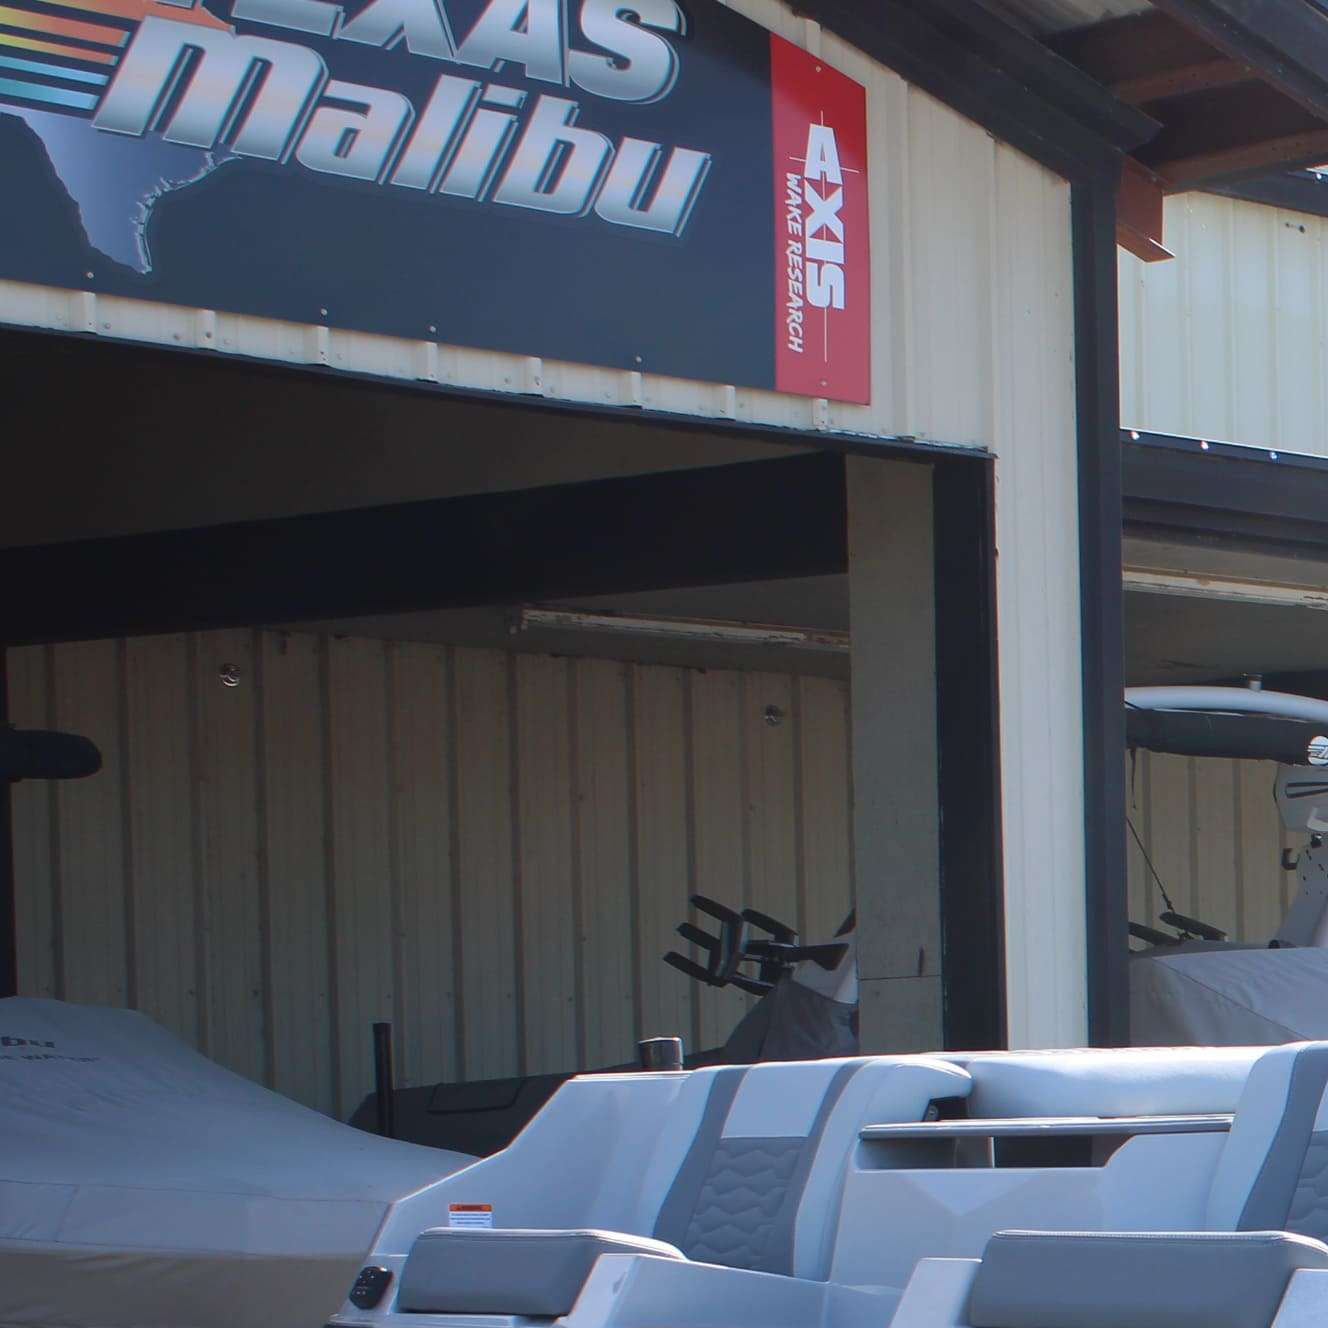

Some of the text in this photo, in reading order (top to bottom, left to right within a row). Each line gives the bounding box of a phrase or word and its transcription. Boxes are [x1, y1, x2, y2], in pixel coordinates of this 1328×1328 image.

[91, 15, 712, 238] Malibu
[158, 0, 686, 104] XAS
[785, 172, 804, 353] WAKE RESEARCH
[804, 123, 845, 310] AXIS
